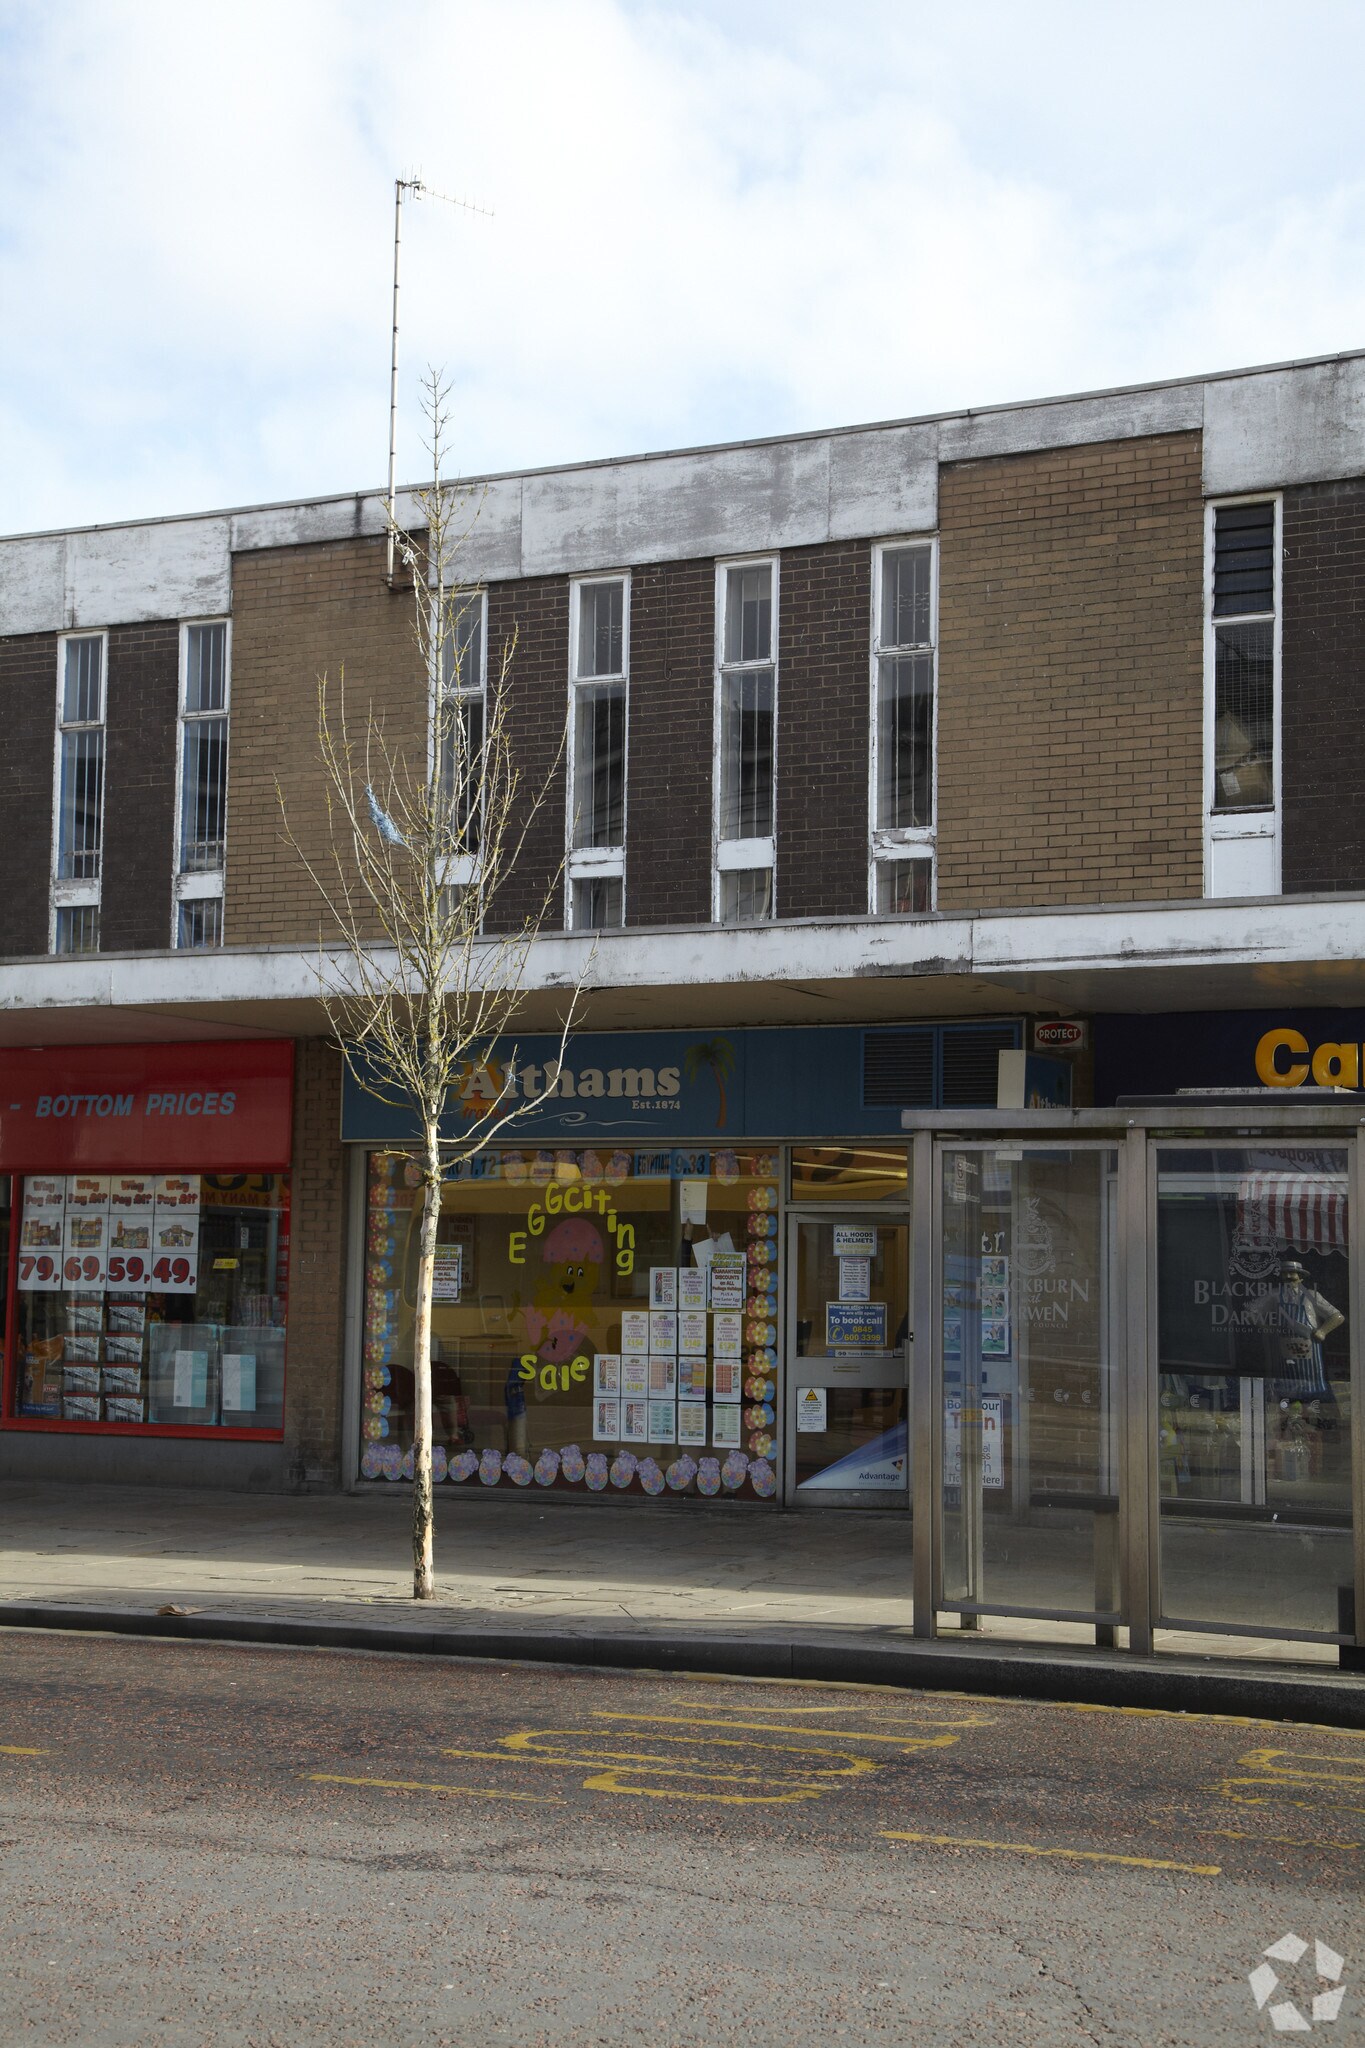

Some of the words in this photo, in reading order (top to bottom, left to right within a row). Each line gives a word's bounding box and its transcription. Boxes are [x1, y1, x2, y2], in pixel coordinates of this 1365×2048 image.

[1039, 1028, 1078, 1039] PROTECT
[1255, 1028, 1365, 1088] Ca
[458, 1061, 681, 1100] Althams
[35, 1094, 135, 1118] BOTTOM
[145, 1092, 236, 1116] PRICES
[631, 1100, 681, 1111] Est.1874
[470, 1155, 497, 1175] 1.12
[674, 1153, 706, 1175] 9.33
[20, 1256, 60, 1283] 79p
[64, 1255, 105, 1283] 69p
[108, 1256, 150, 1284] 59p
[153, 1257, 196, 1286] 49p
[830, 1316, 840, 1324] To
[842, 1316, 864, 1324] book
[866, 1316, 882, 1324] call
[859, 1472, 900, 1482] Advantage
